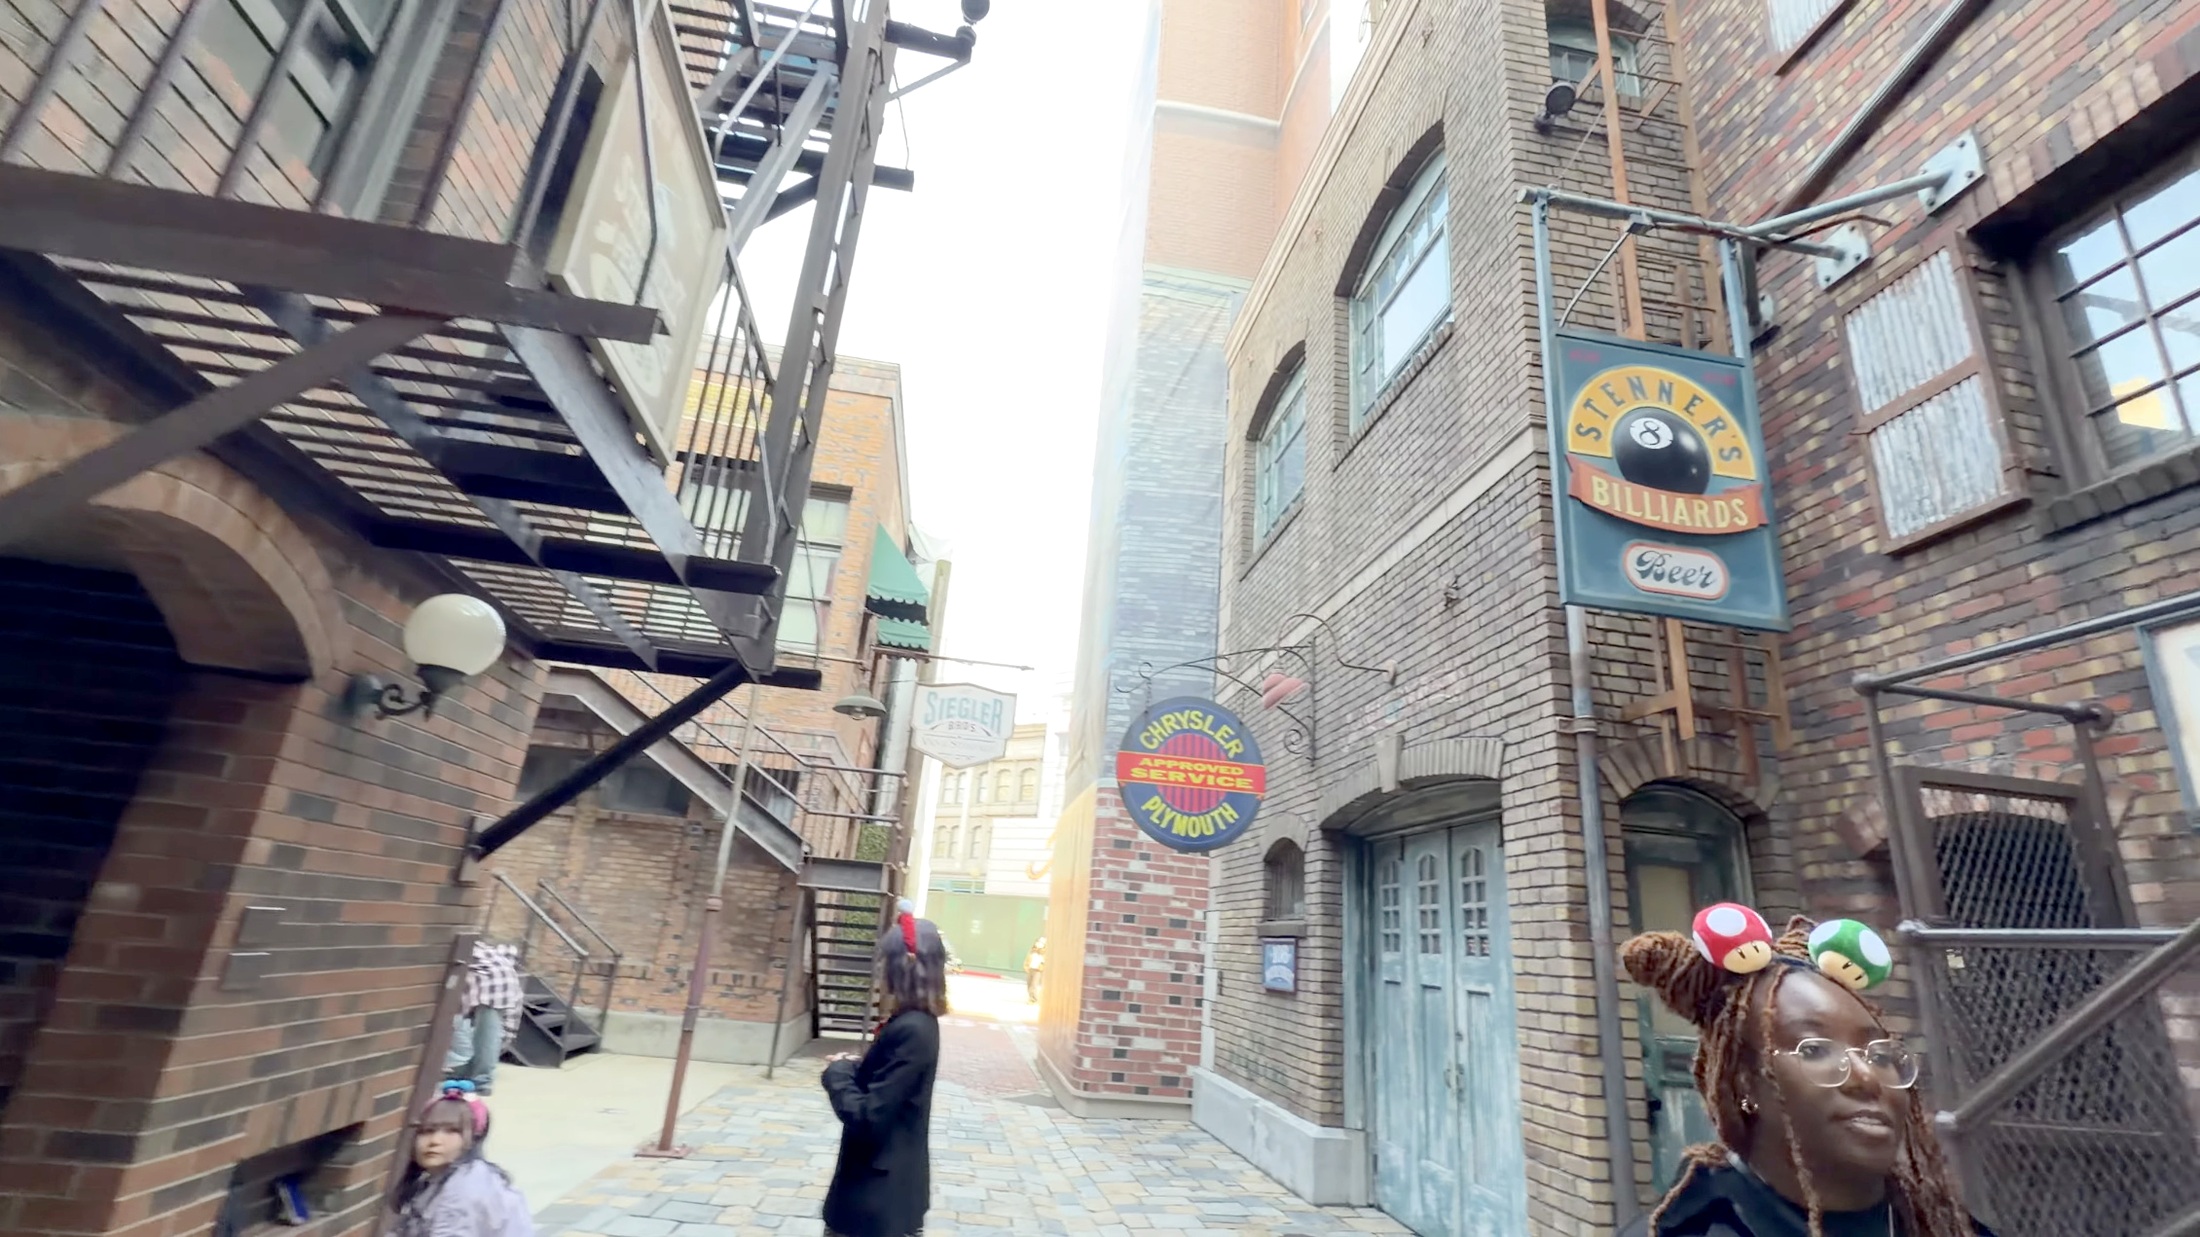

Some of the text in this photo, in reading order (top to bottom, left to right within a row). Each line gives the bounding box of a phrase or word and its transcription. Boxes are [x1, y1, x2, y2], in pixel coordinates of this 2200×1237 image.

[1575, 375, 1742, 462] STENNER'S
[1640, 420, 1660, 445] 8
[1592, 476, 1749, 528] BILLIARDS
[1635, 550, 1718, 589] Beer
[924, 692, 1003, 734] SIEGLER
[1140, 710, 1244, 758] CHRYSLER
[1130, 768, 1253, 788] SERVICE
[1139, 758, 1244, 775] APPROVED
[1141, 796, 1239, 837] PLYMOUTH
